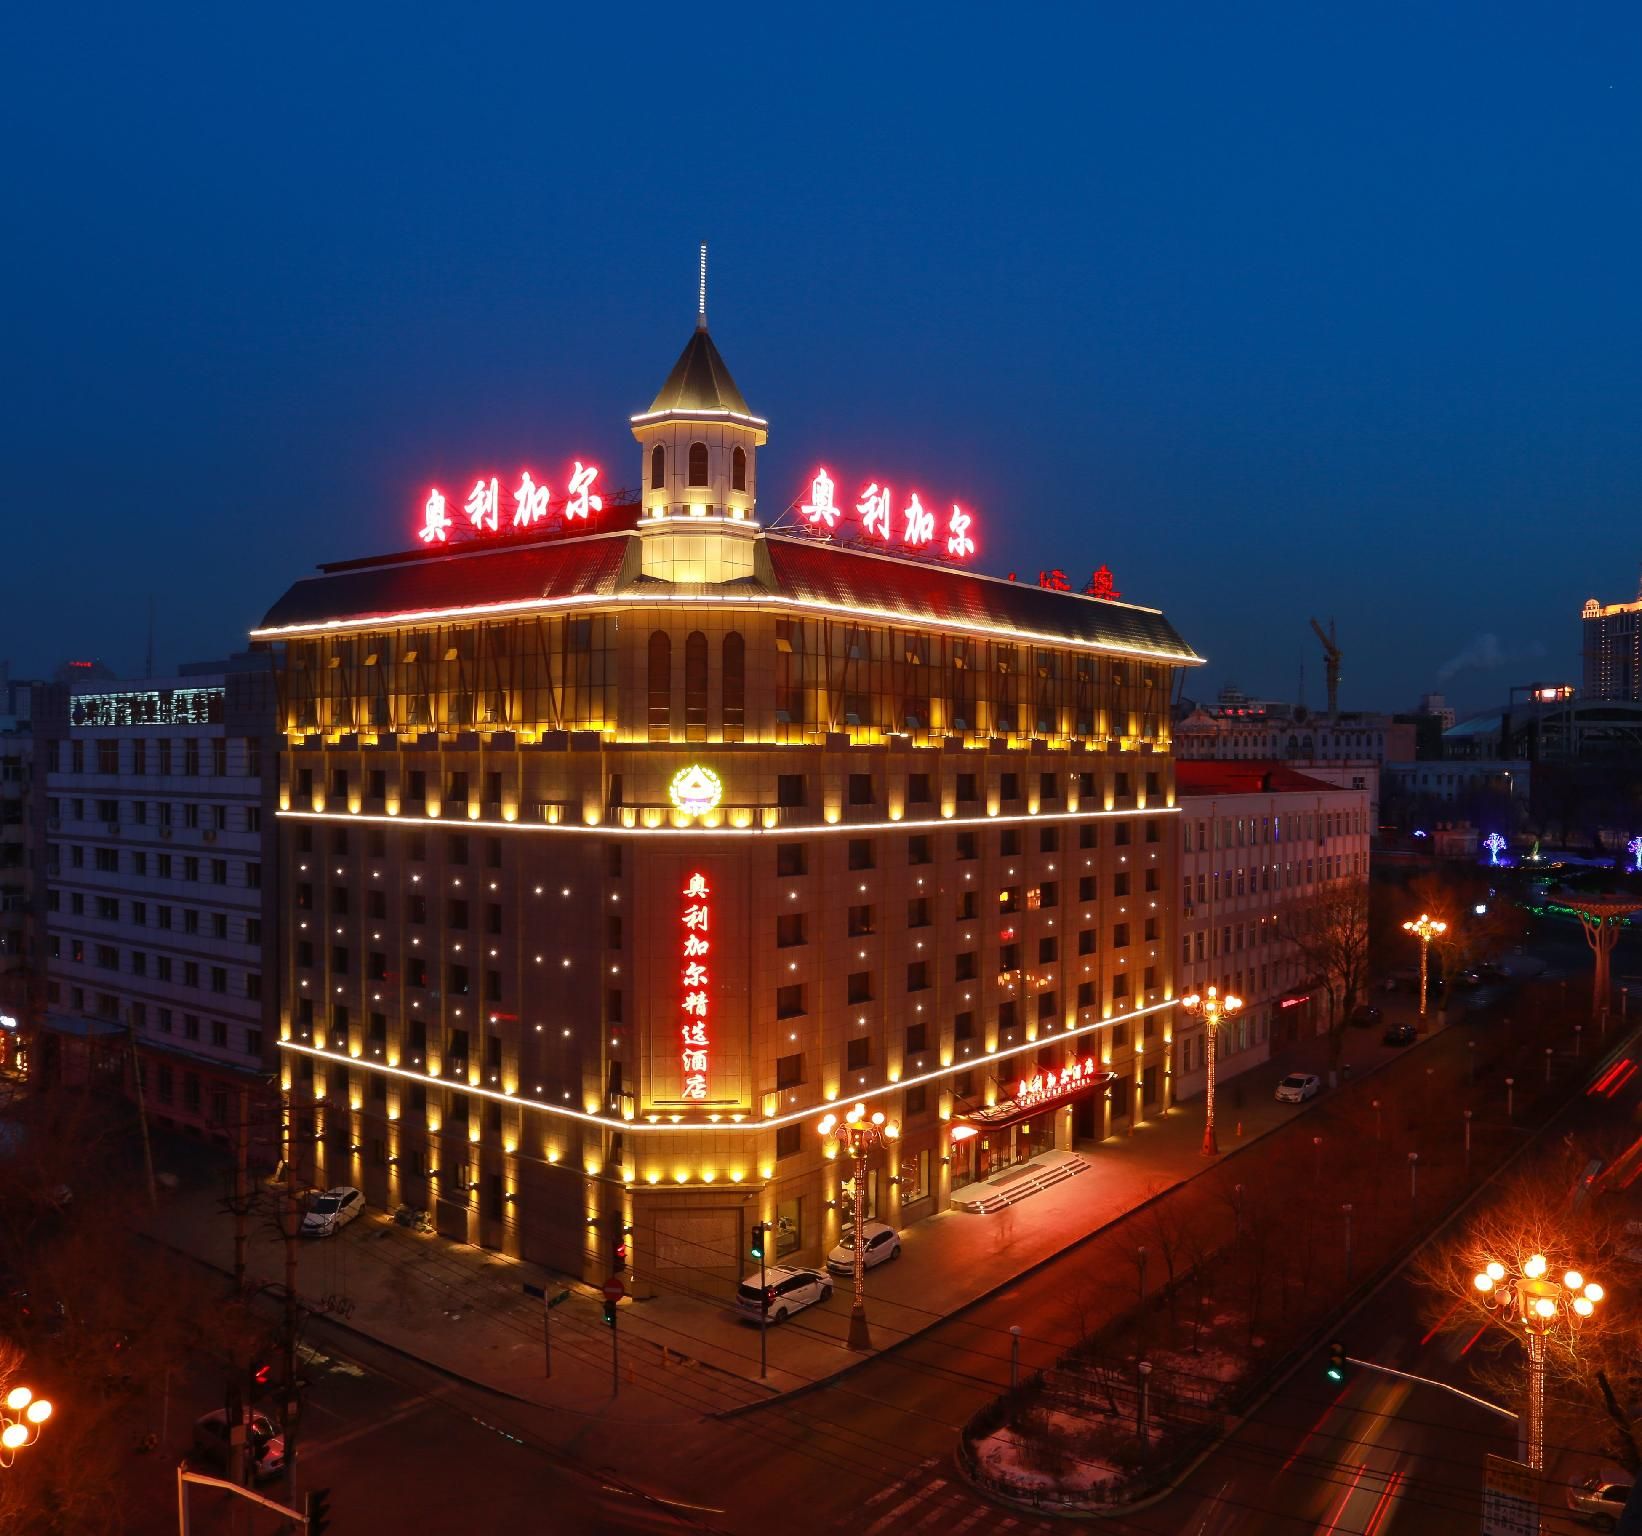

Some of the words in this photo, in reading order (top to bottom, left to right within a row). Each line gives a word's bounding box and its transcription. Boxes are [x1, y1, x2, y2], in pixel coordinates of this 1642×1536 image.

[418, 460, 603, 544] 奥利加尔
[801, 467, 976, 558] 奥利加尔
[681, 872, 710, 1100] 奥利加尔精选酒店
